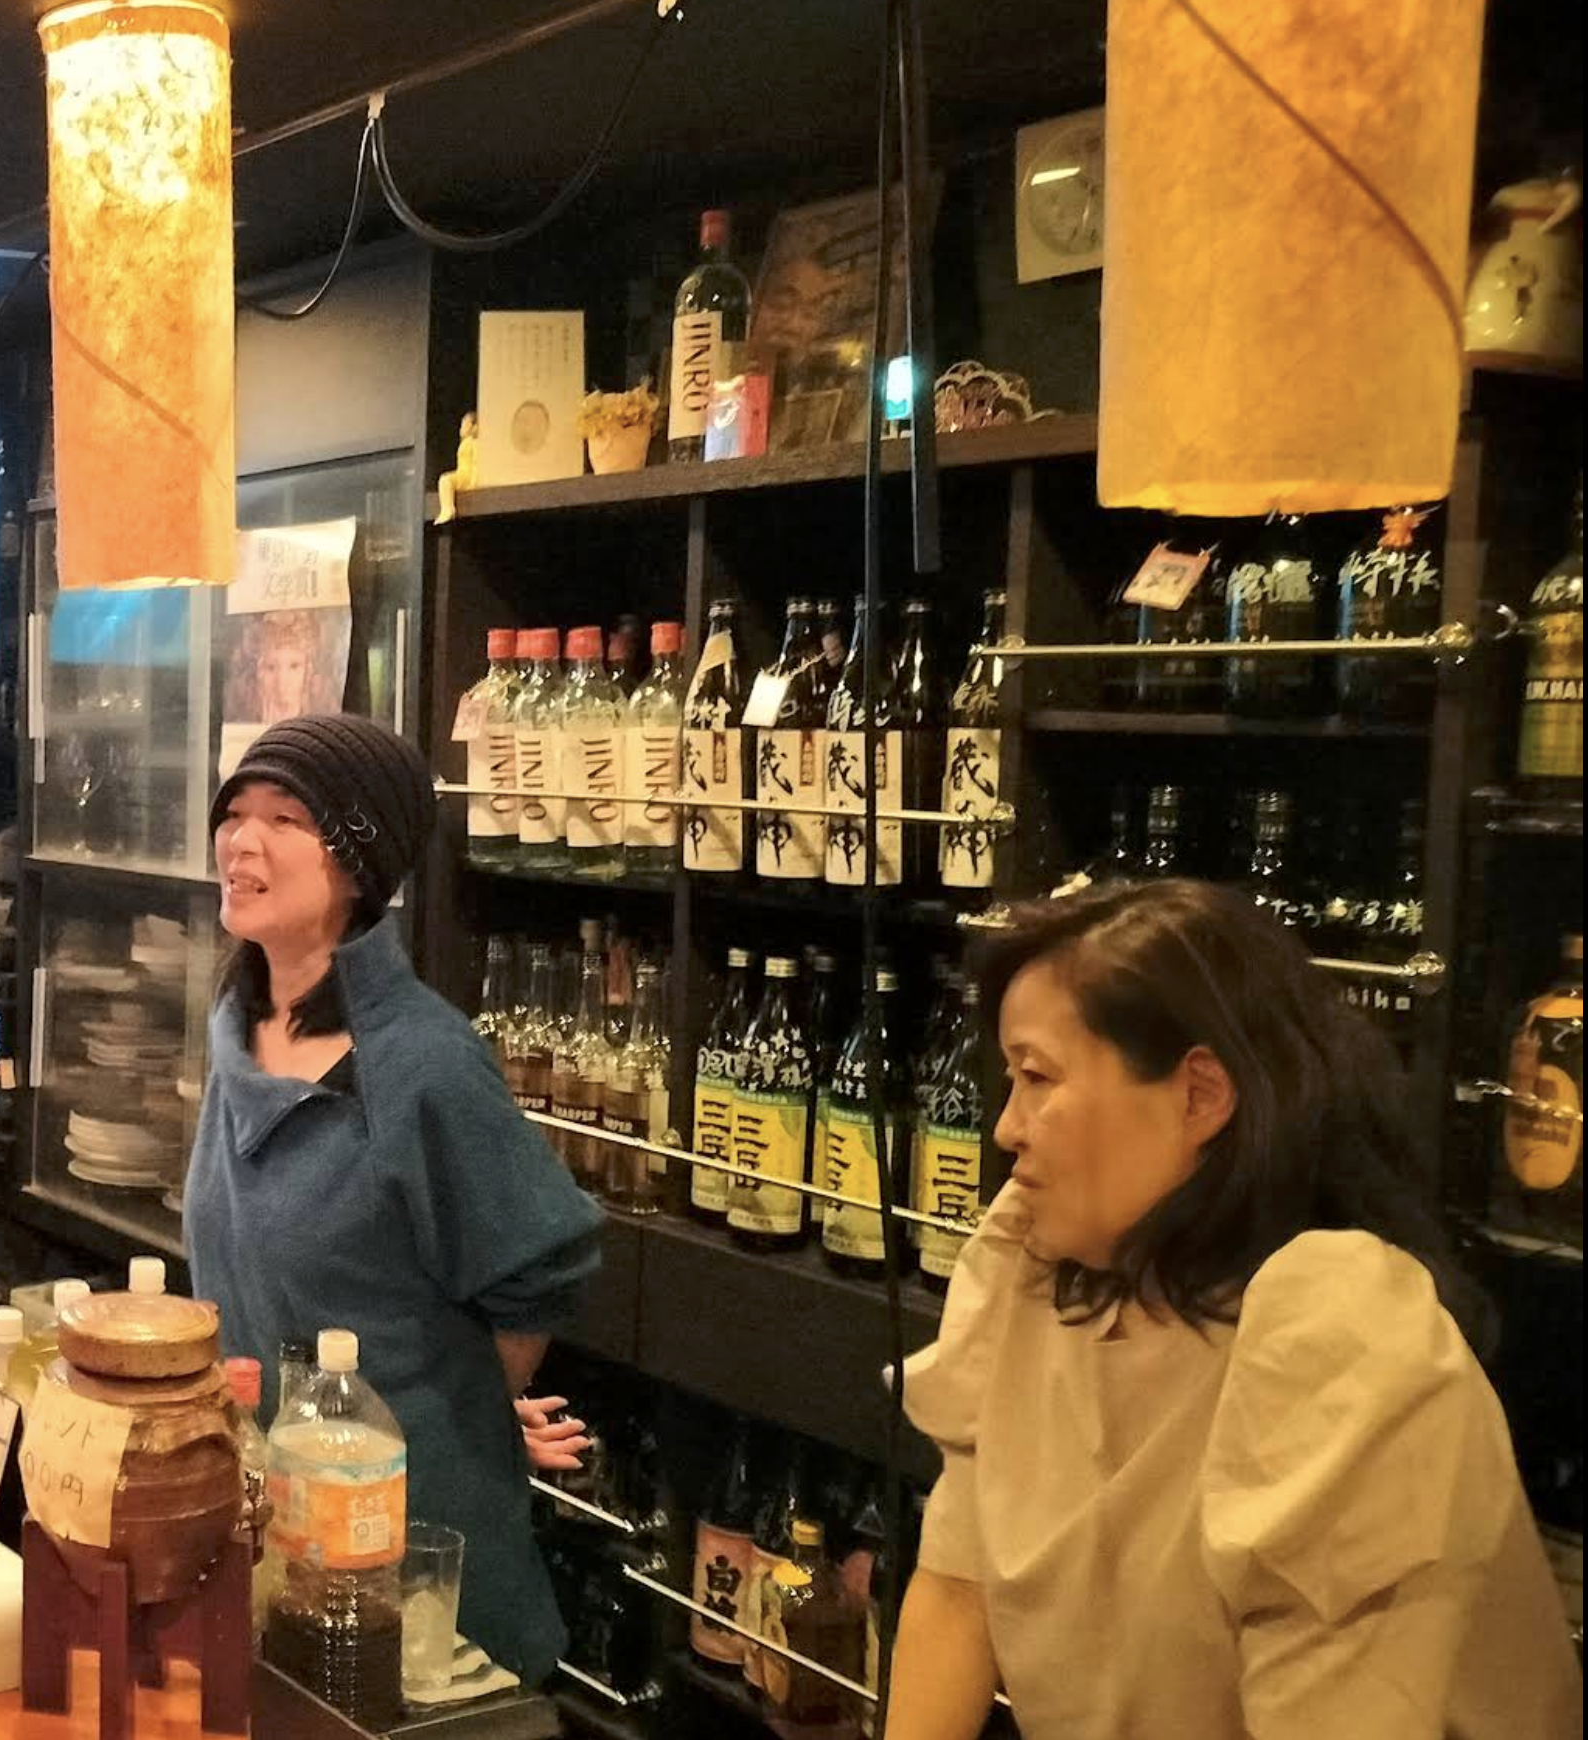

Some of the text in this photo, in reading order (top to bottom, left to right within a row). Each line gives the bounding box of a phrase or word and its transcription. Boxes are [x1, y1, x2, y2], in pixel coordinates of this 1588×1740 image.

[682, 320, 712, 412] JINRO
[519, 738, 548, 821] JINO
[760, 737, 794, 869] 蔵神
[825, 740, 866, 875] 蔵神
